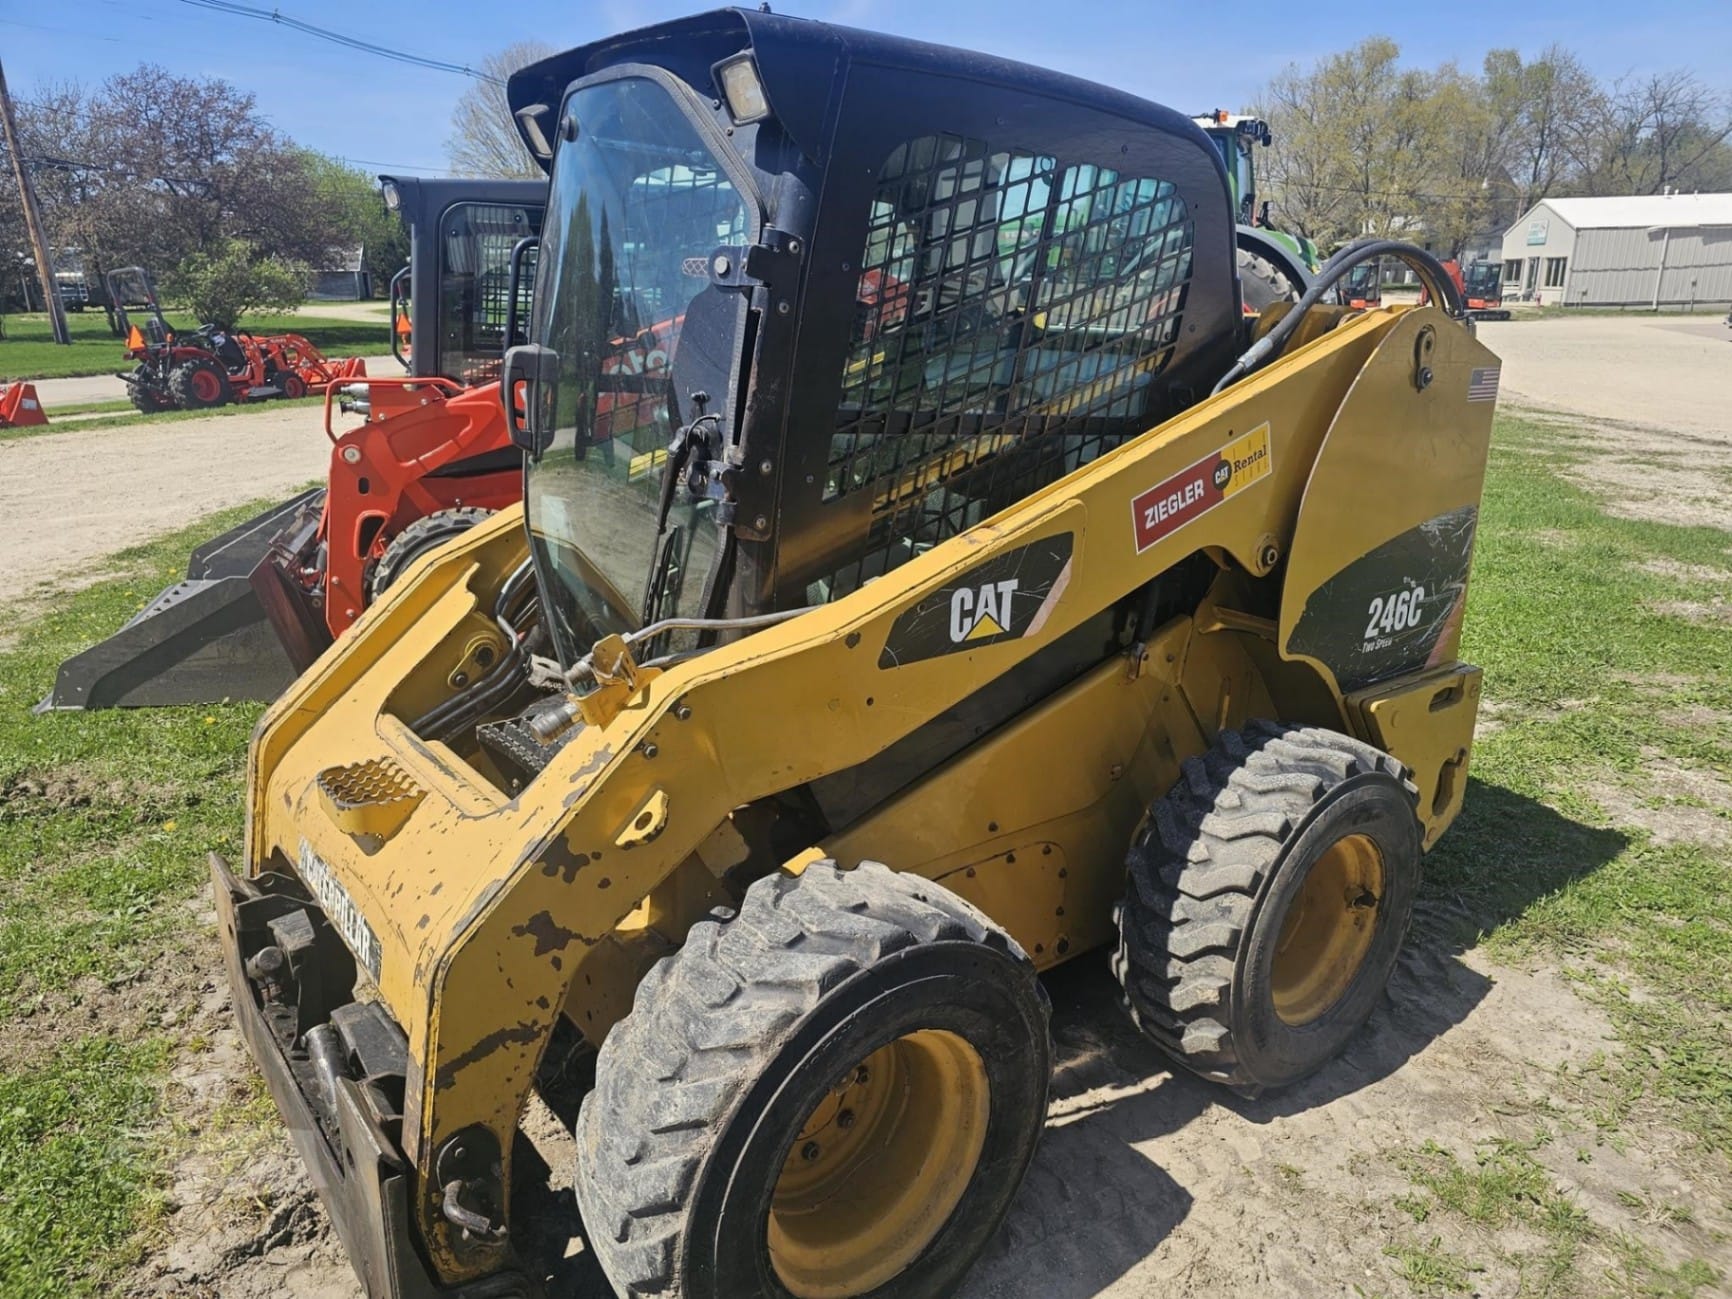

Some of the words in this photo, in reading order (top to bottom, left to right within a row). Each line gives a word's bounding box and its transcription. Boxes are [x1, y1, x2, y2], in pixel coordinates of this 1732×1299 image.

[1144, 479, 1205, 530] ZIEGLER
[1214, 465, 1230, 485] CAT
[1233, 444, 1267, 473] Rental
[950, 578, 1019, 643] CAT
[1364, 586, 1425, 639] 246C
[305, 847, 371, 968] CERPILLAR
